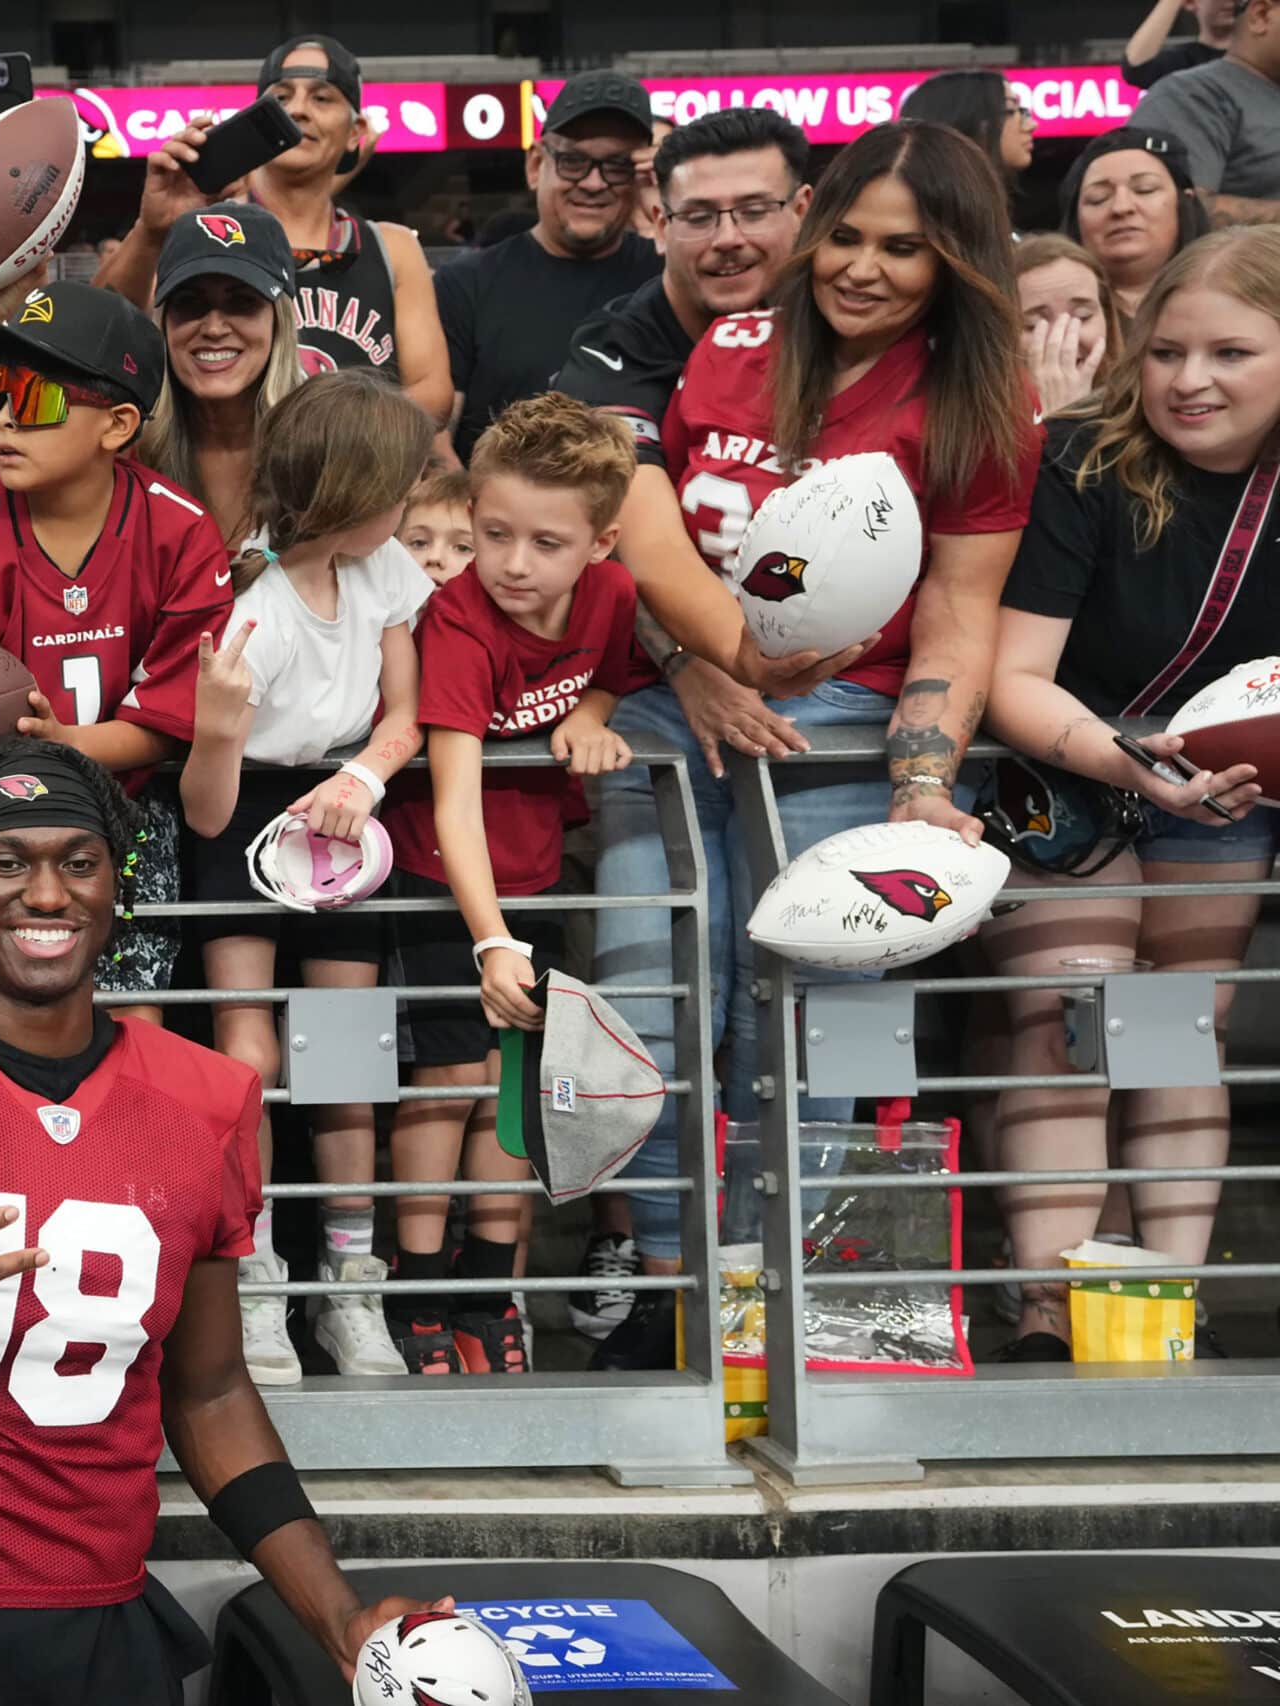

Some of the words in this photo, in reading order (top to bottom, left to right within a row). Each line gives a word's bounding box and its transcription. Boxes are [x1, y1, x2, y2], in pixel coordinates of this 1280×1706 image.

[463, 94, 505, 140] 0
[836, 87, 892, 125] US
[32, 626, 125, 647] CARDINALS
[455, 1603, 618, 1622] ECYCLE
